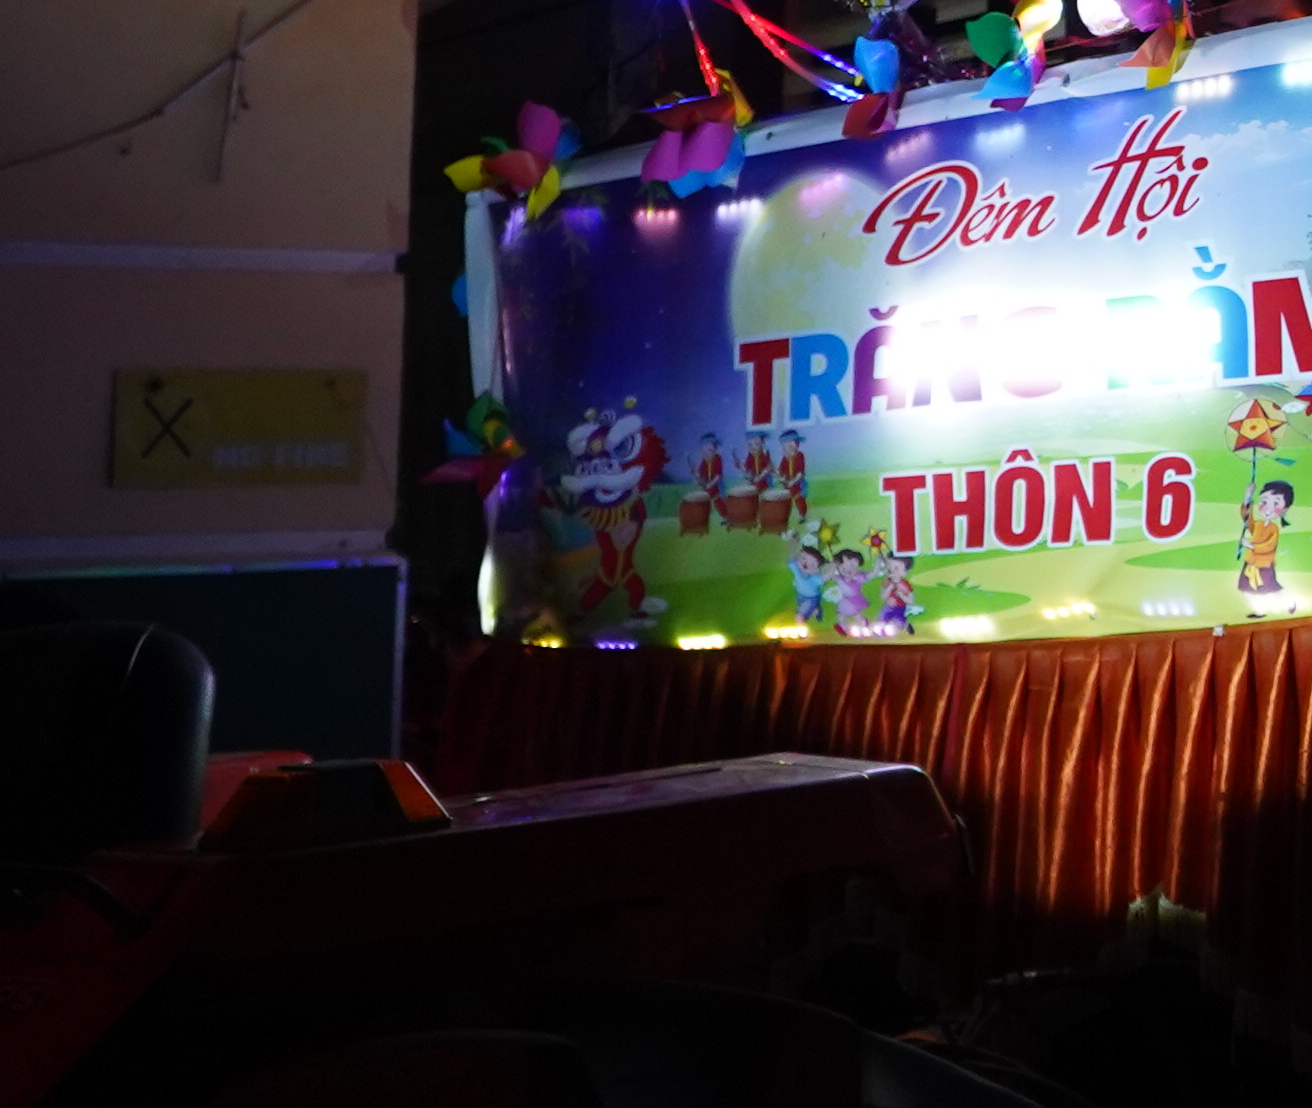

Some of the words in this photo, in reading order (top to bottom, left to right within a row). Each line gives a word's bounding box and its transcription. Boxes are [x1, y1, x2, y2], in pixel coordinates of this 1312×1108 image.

[861, 163, 1057, 266] Đêm
[1076, 107, 1210, 242] Hội
[882, 449, 1114, 552] THÔN
[1144, 455, 1193, 538] 6
